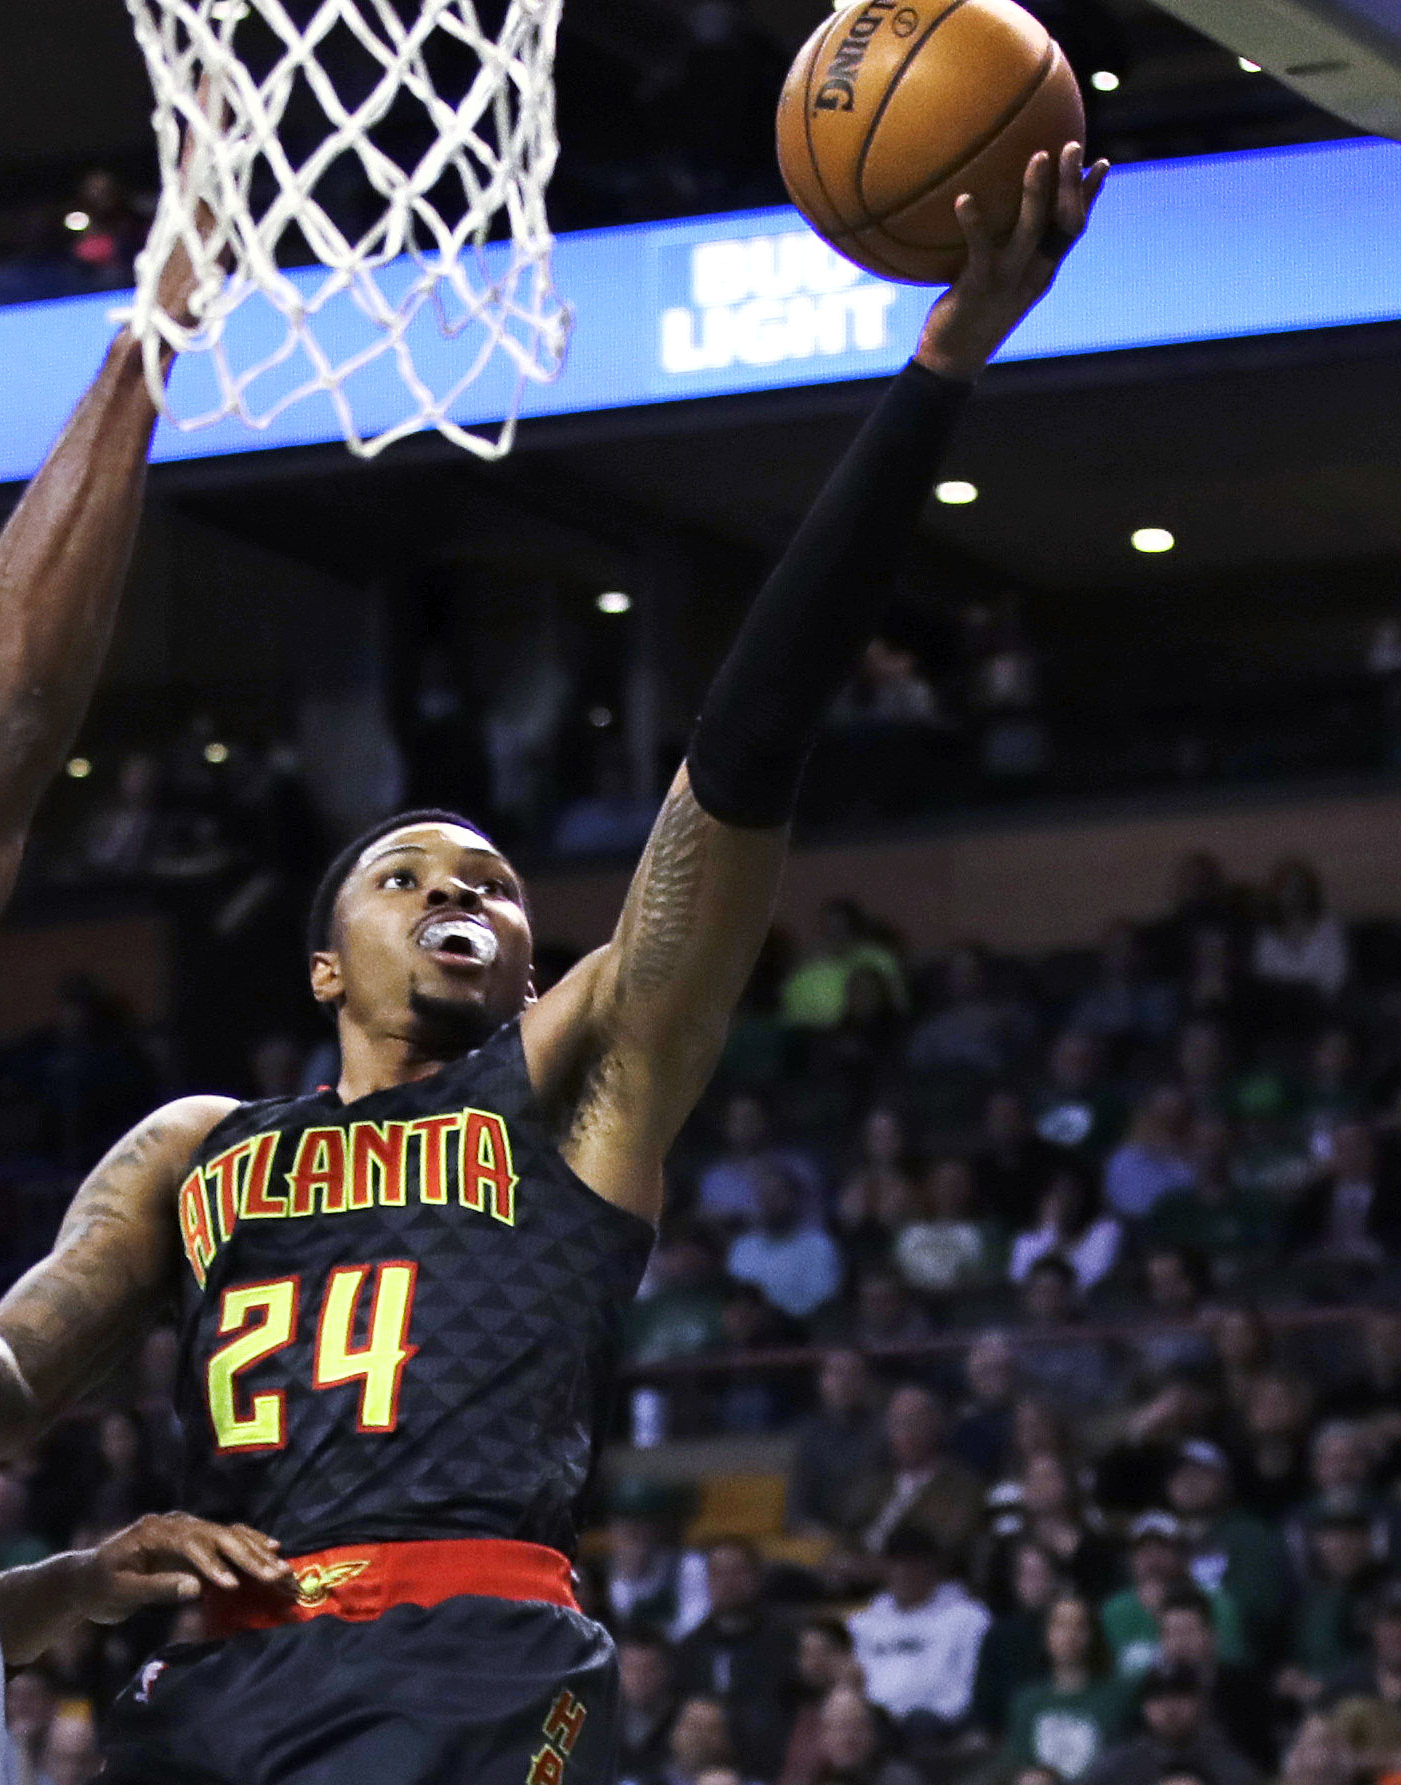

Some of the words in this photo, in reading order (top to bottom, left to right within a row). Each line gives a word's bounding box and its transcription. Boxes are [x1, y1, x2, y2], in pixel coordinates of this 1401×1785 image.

[814, 0, 897, 113] LDING
[661, 283, 896, 373] LIGHT
[179, 1107, 519, 1290] ATLANTA
[205, 1261, 419, 1454] 24
